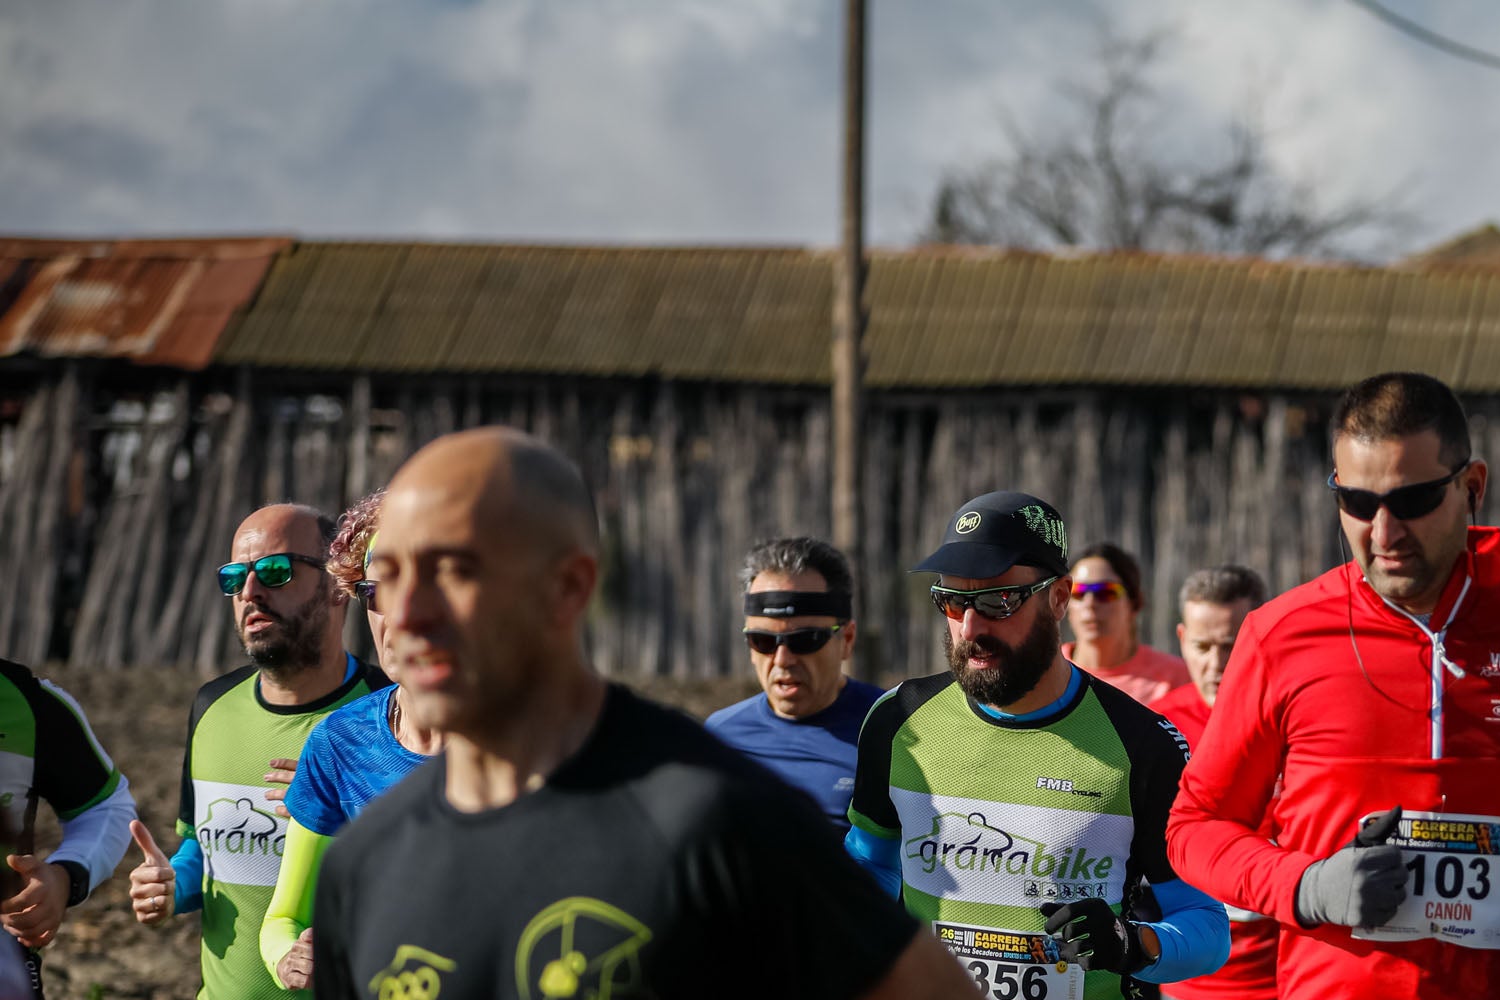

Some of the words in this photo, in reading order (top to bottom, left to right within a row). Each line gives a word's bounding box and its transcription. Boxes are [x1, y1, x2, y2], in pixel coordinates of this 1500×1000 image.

[959, 515, 979, 531] Buff
[1036, 776, 1072, 792] FMB
[1412, 820, 1476, 834] CARRERA
[1408, 838, 1447, 849] Secaderos
[1411, 830, 1475, 842] POPULAR
[1406, 853, 1491, 901] 103
[1425, 900, 1473, 921] CANÓN
[940, 927, 955, 940] 26
[964, 930, 976, 948] VII
[975, 931, 1028, 946] CARRERA
[961, 946, 971, 954] los
[971, 947, 1003, 958] Secaderos
[974, 940, 1028, 953] POPULAR
